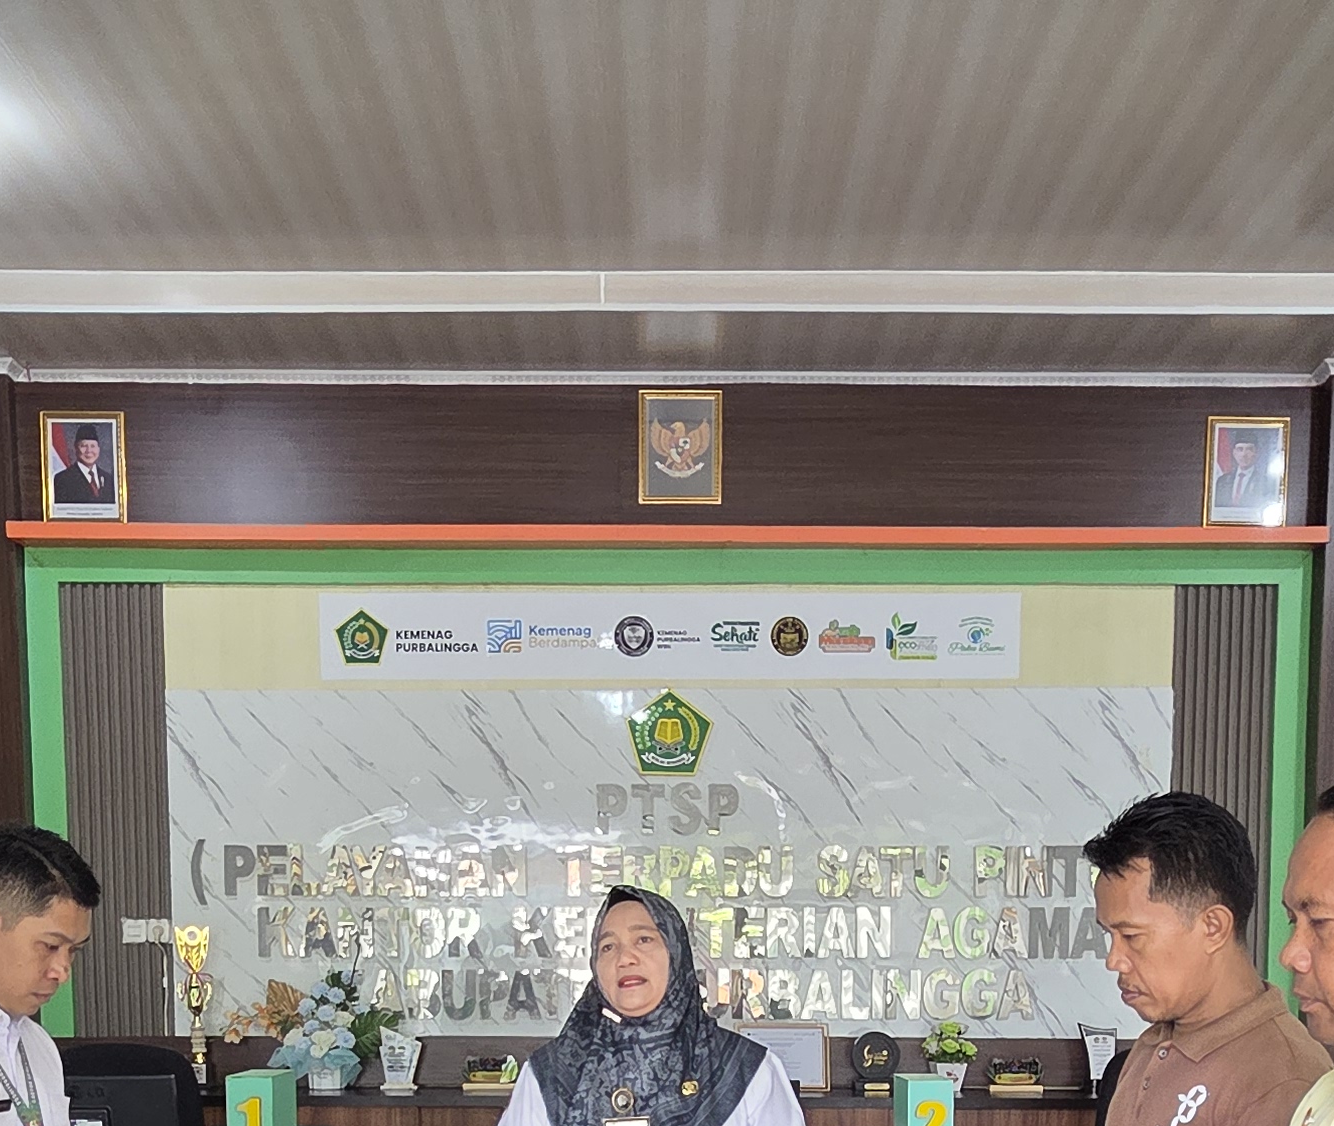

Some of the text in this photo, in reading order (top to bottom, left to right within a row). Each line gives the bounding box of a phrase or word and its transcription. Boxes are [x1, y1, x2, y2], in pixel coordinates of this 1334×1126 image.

[396, 625, 592, 640] KEMENAG Kemenag
[396, 643, 479, 653] PURBALINGGA
[710, 623, 760, 645] Sehati
[596, 783, 740, 836] PTSP
[223, 844, 528, 898] PELAYANAN
[558, 844, 794, 898] TERPADU
[817, 844, 951, 899] SATU
[973, 844, 1099, 899] PINT
[257, 905, 482, 959] KANTOR
[918, 905, 1107, 960] AGAMA
[699, 967, 1034, 1021] URBALINGGA
